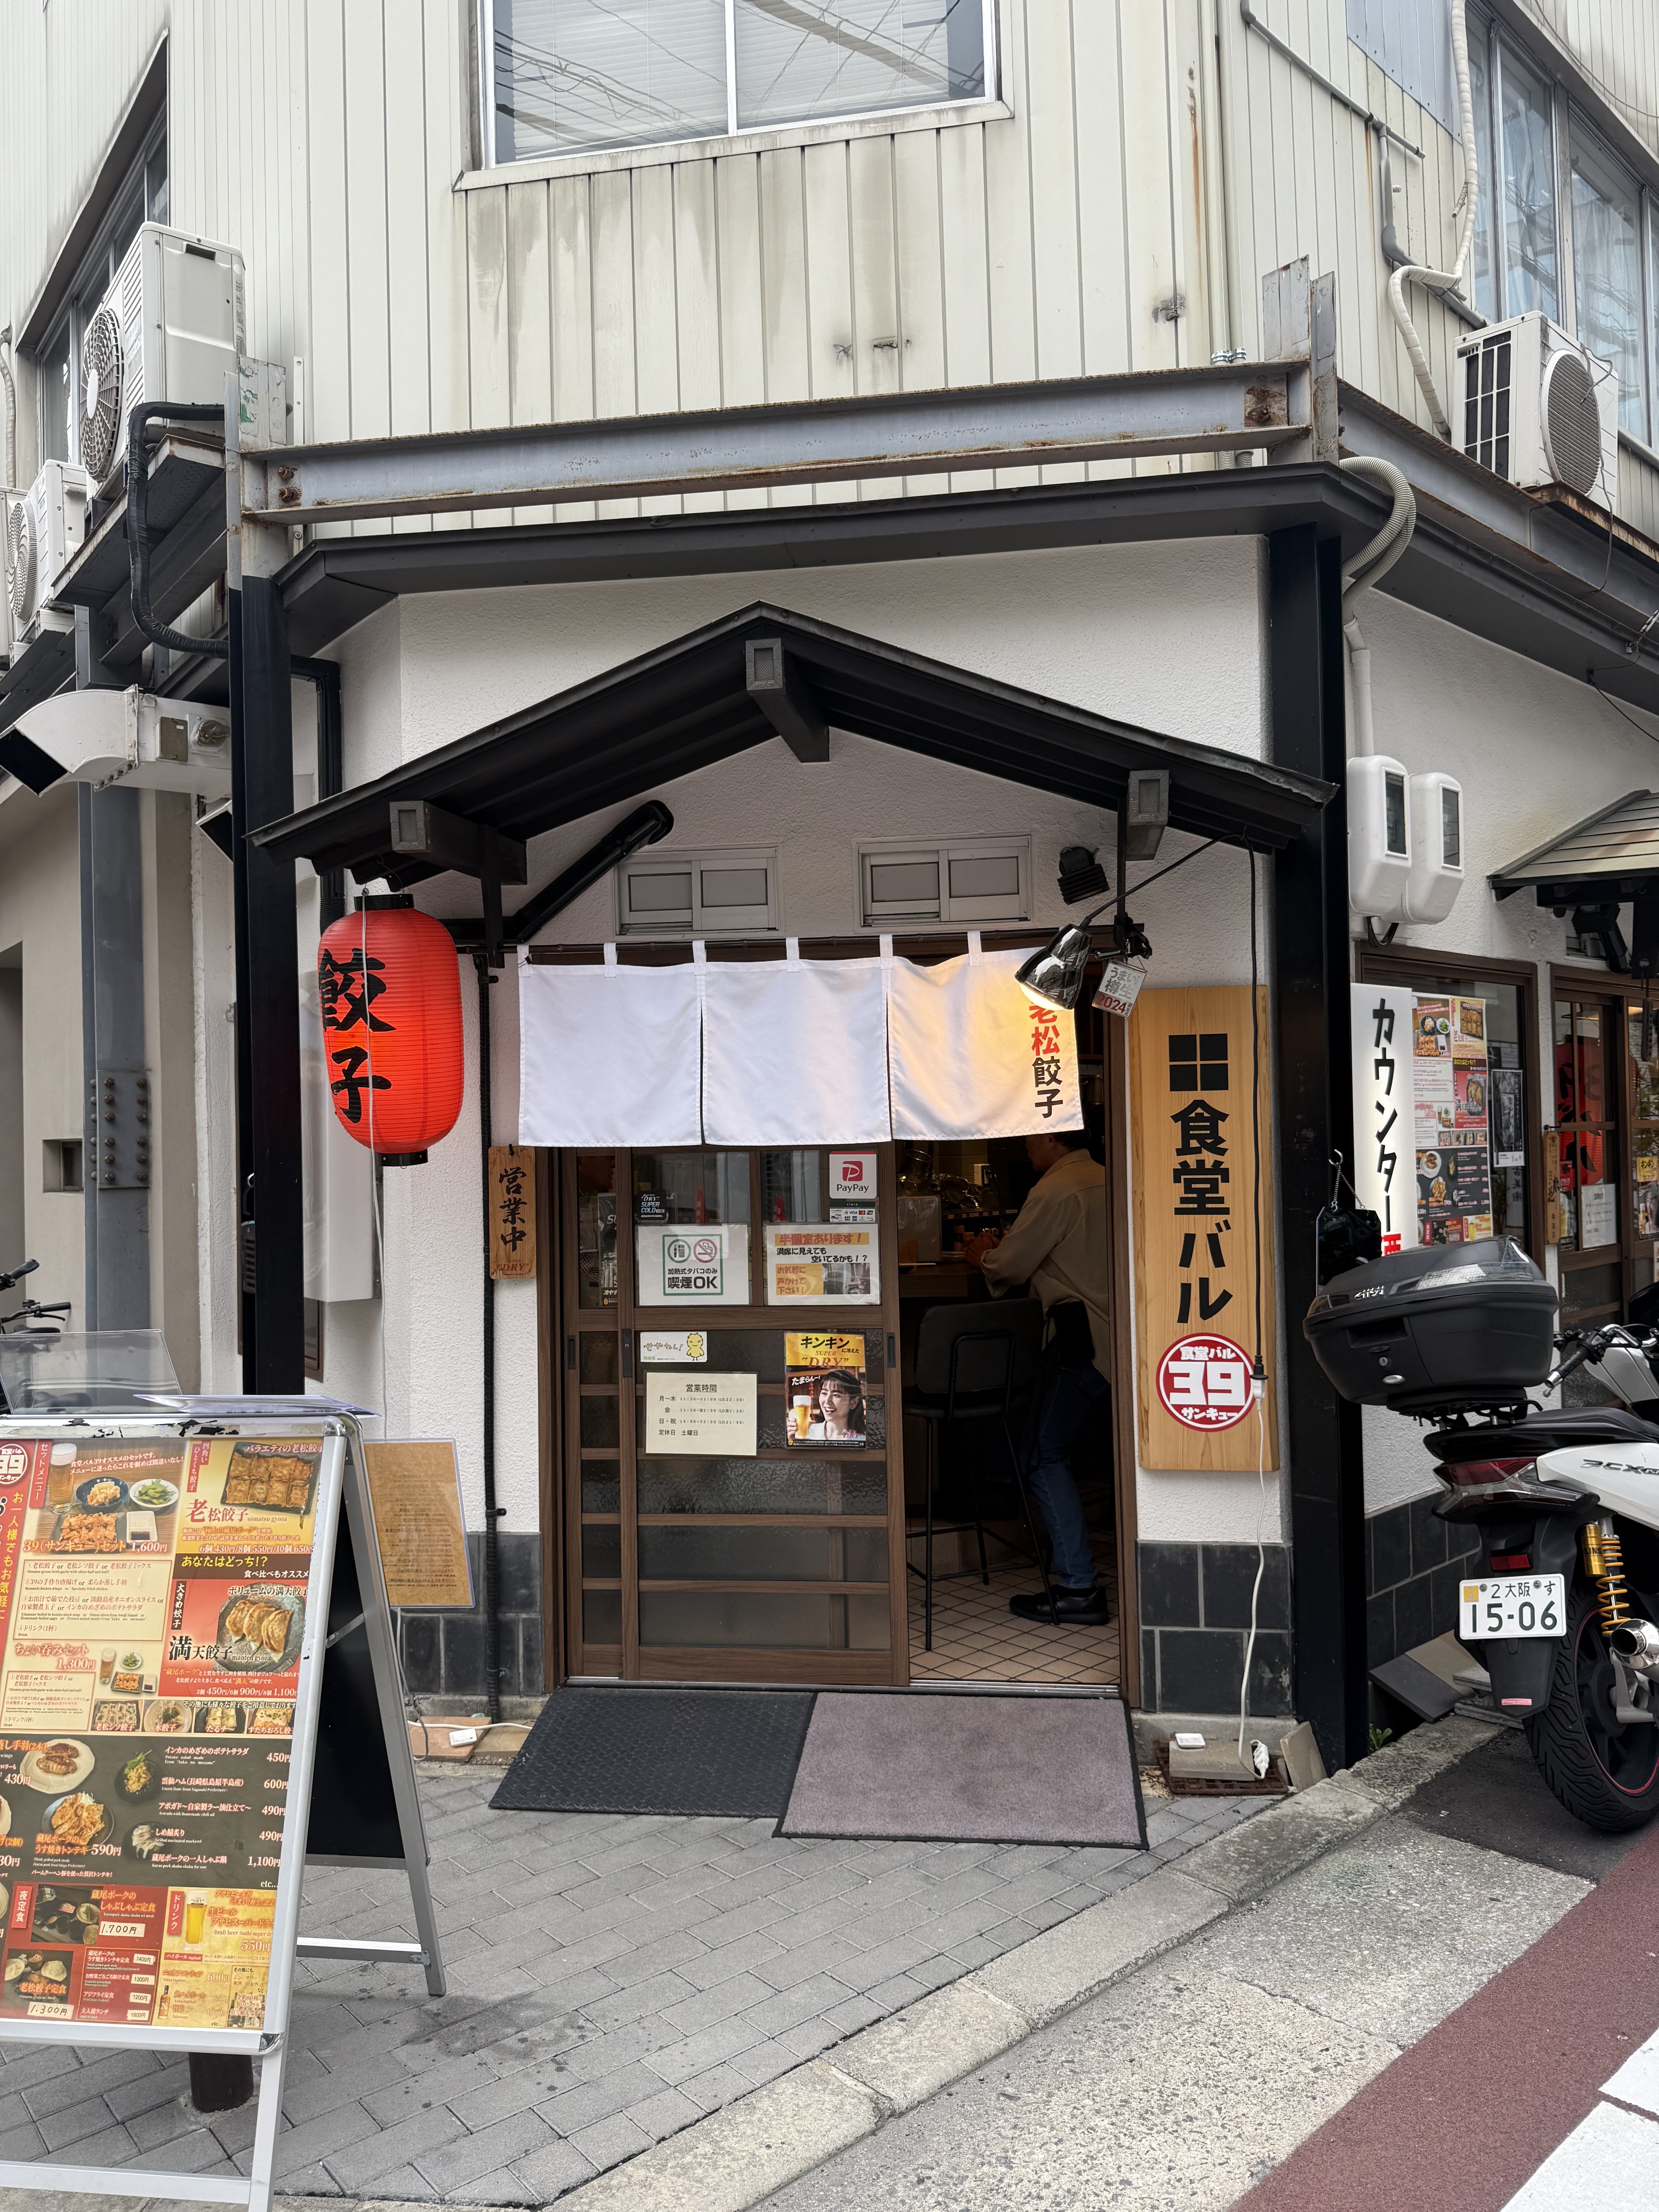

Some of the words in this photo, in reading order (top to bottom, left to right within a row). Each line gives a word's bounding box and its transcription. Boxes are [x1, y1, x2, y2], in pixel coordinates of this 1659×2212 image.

[1105, 978, 1134, 999] 樽生
[1096, 993, 1127, 1013] 2024
[320, 948, 397, 1123] 餃子
[837, 1184, 869, 1193] PayPay
[499, 1166, 527, 1252] 営業中
[1170, 1099, 1233, 1324] 食堂バル
[776, 1247, 827, 1255] 満席に見えても
[668, 1276, 718, 1289] 喫煙OK
[800, 1336, 850, 1349] キンキン
[1180, 1346, 1236, 1360] 食堂バル
[686, 1384, 717, 1392] 営業時間
[1168, 1361, 1245, 1406] 39
[1181, 1407, 1240, 1420] サンキュー
[201, 1443, 210, 1463] 四角い
[36, 1443, 48, 1500] セットメニュー
[189, 1447, 199, 1491] ひとくち餃子
[185, 1499, 249, 1522] 老松餃子
[24, 1540, 126, 1553] 39(サンキュー)セット
[131, 1542, 167, 1554] 1,600円
[199, 1545, 213, 1553] 6個
[244, 1570, 309, 1578] 食べ比べもオススメ
[228, 1586, 309, 1596] ボリュームの満天餃子
[1544, 1581, 1556, 1595] す
[173, 1583, 185, 1628] 大きめ餃子
[1472, 1600, 1557, 1633] 15-06
[16, 1644, 88, 1656] ちょい呑みセット
[168, 1635, 233, 1661] 満天餃子
[57, 1658, 96, 1670] 1,300円
[95, 1723, 135, 1731] 老松シソ餃子
[155, 1724, 176, 1733] 水餃子
[165, 1746, 250, 1755] インカのめざめのポテトサラダ
[266, 1752, 291, 1763] 450円
[4, 1773, 31, 1785] 430円
[264, 1779, 289, 1790] 600円
[262, 1805, 286, 1816] 490円
[259, 1831, 283, 1841] 490円
[35, 1845, 88, 1855] うす焼きトンテキ
[91, 1844, 122, 1856] 590円
[247, 1856, 281, 1867] 1,100円
[91, 1889, 137, 1900] 蔵尾ポークの
[16, 1890, 28, 1922] 夜定食
[100, 1902, 156, 1913] しゃぶしゃぶ定食
[170, 1894, 181, 1930] ドリンク
[208, 1908, 238, 1916] 生ビール
[241, 1940, 271, 1953] 550円
[207, 1972, 231, 1982] 600円
[19, 1982, 67, 1994] 老松餃子定食
